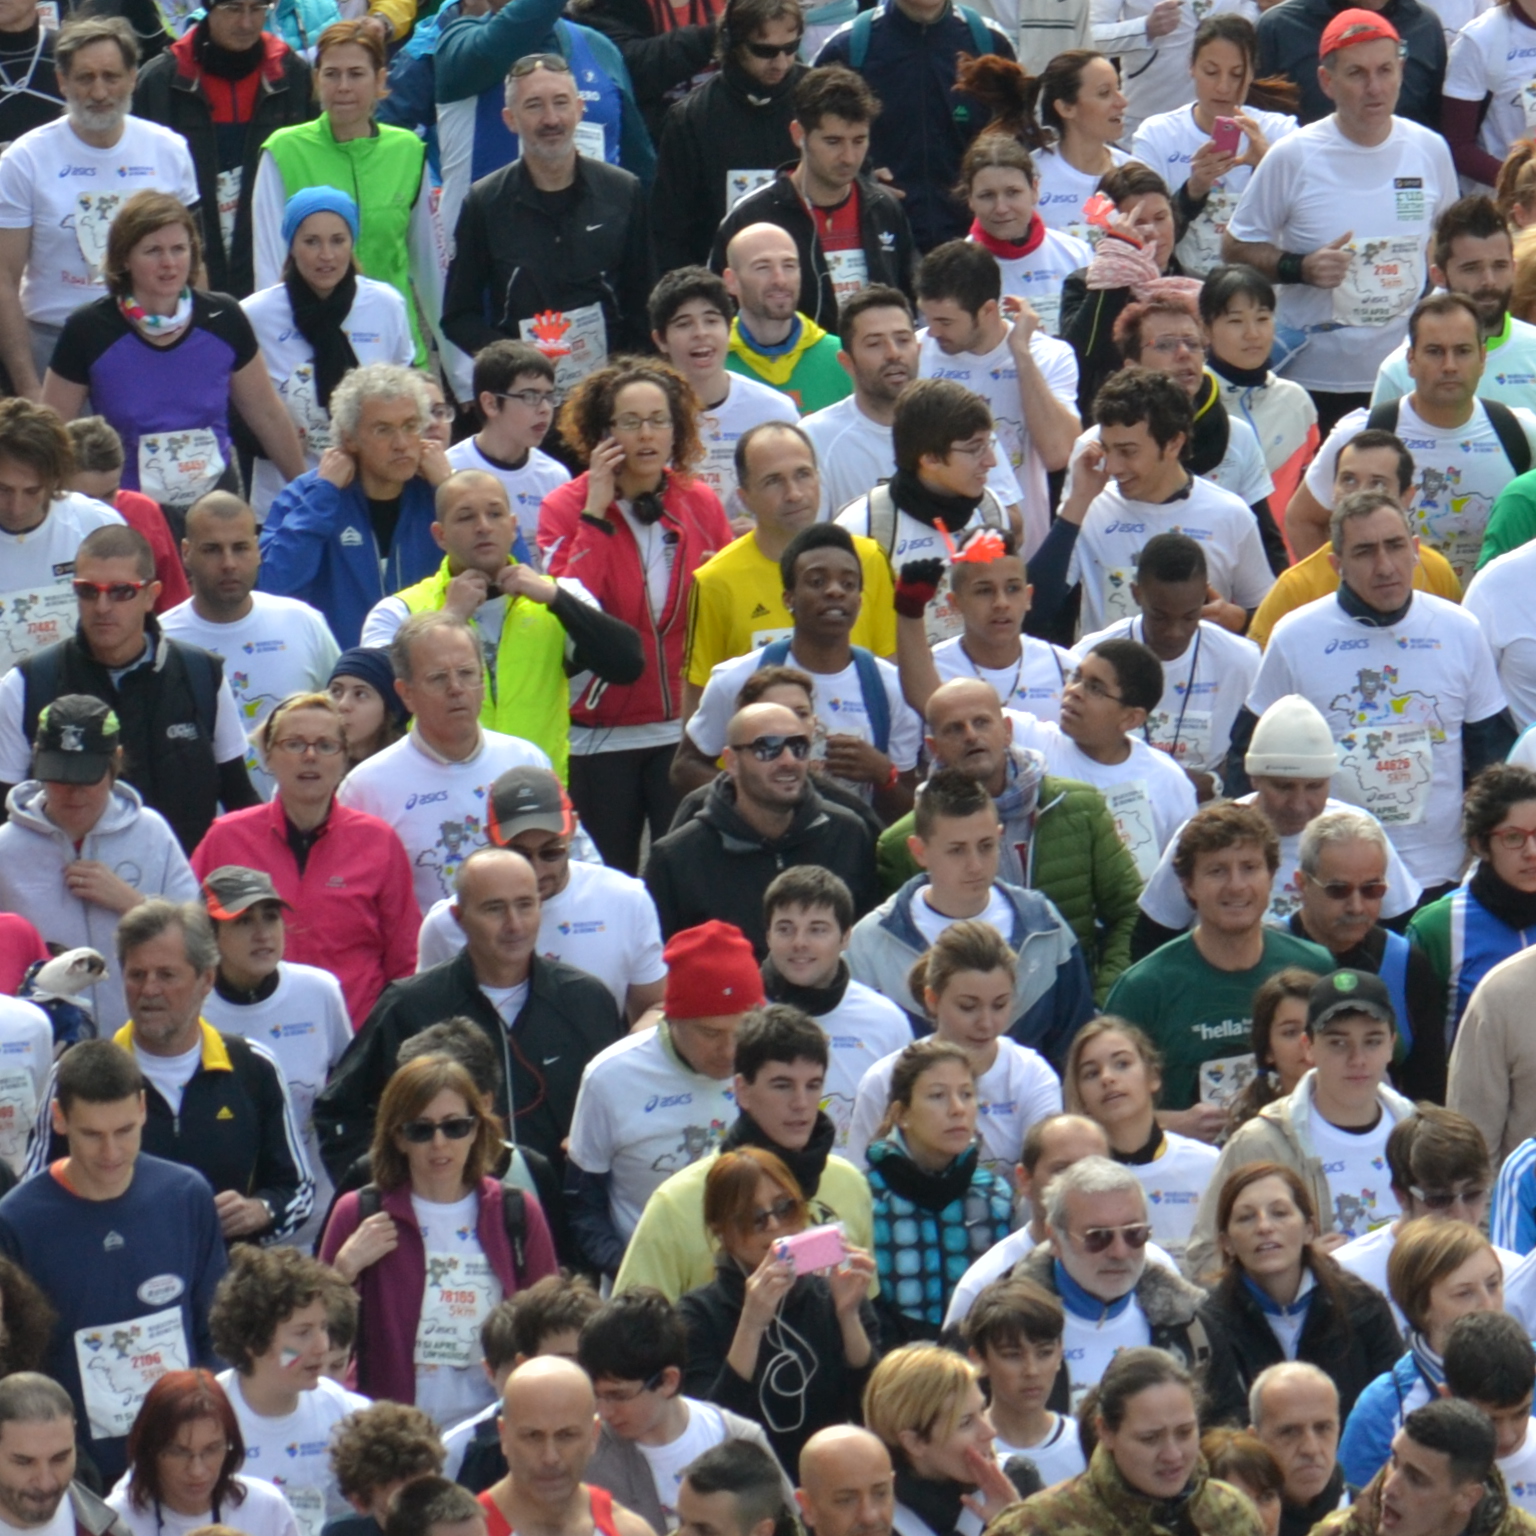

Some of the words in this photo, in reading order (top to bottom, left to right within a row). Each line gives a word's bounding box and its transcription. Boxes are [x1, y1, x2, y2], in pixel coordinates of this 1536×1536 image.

[942, 370, 970, 380] asics
[1409, 439, 1436, 449] asics
[1119, 523, 1145, 533] asics
[908, 537, 933, 550] asics
[1340, 638, 1369, 651] asics
[420, 790, 448, 804] asics
[660, 1093, 692, 1107] asics
[131, 1353, 161, 1369] 2106
